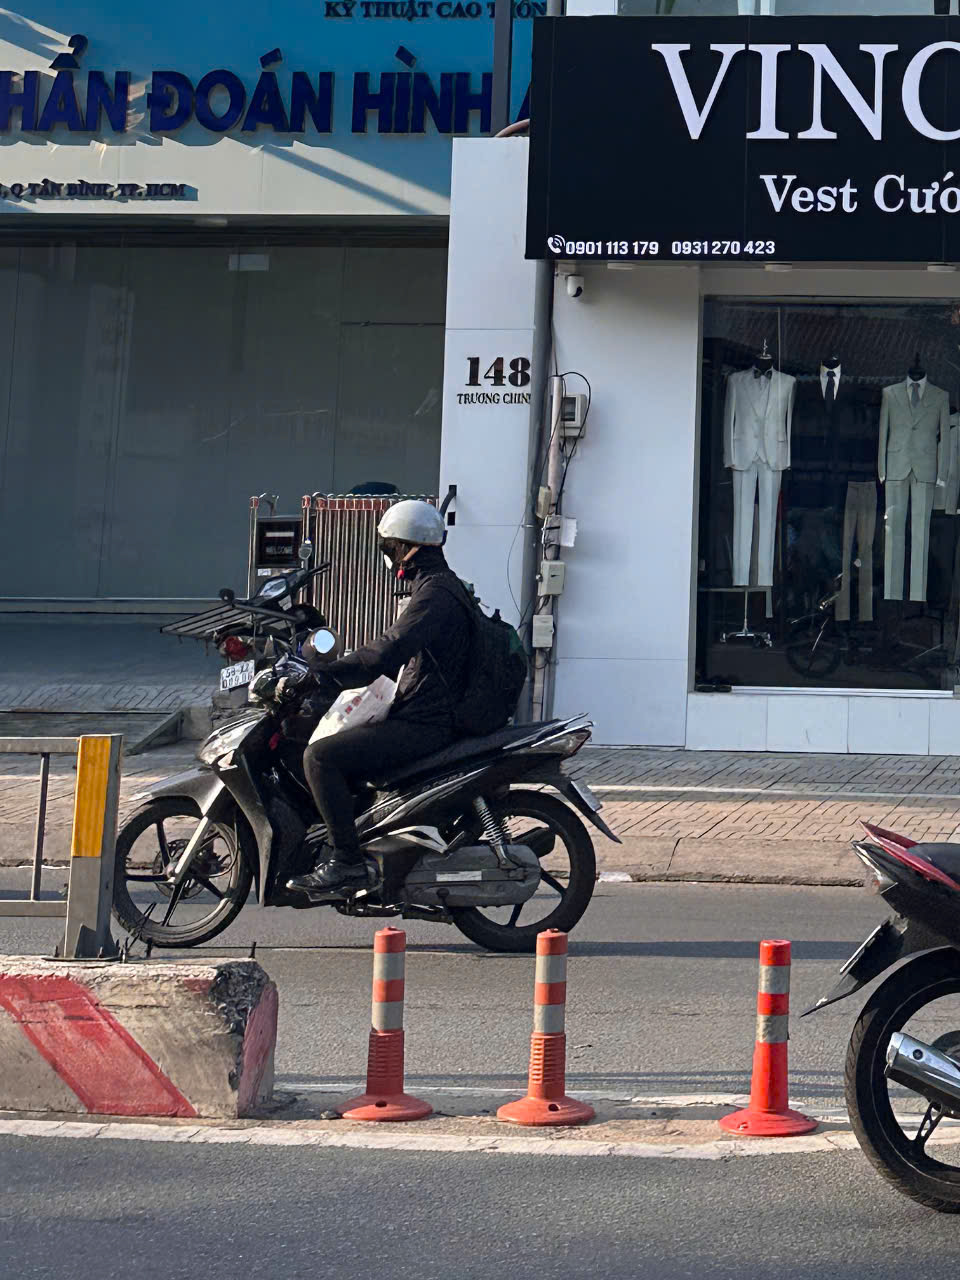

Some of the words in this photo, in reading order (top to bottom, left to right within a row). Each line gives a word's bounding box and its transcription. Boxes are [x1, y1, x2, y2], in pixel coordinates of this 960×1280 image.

[436, 1, 482, 18] CAO
[147, 48, 333, 134] ĐOÁN
[351, 45, 494, 134] HÌNH
[760, 175, 857, 213] Vest
[566, 241, 602, 255] 0901
[606, 241, 629, 255] 113
[632, 241, 659, 255] 179
[671, 241, 708, 255] 0931
[711, 241, 741, 255] 270
[744, 241, 776, 255] 423
[465, 356, 531, 388] 148
[503, 392, 532, 405] CHIN
